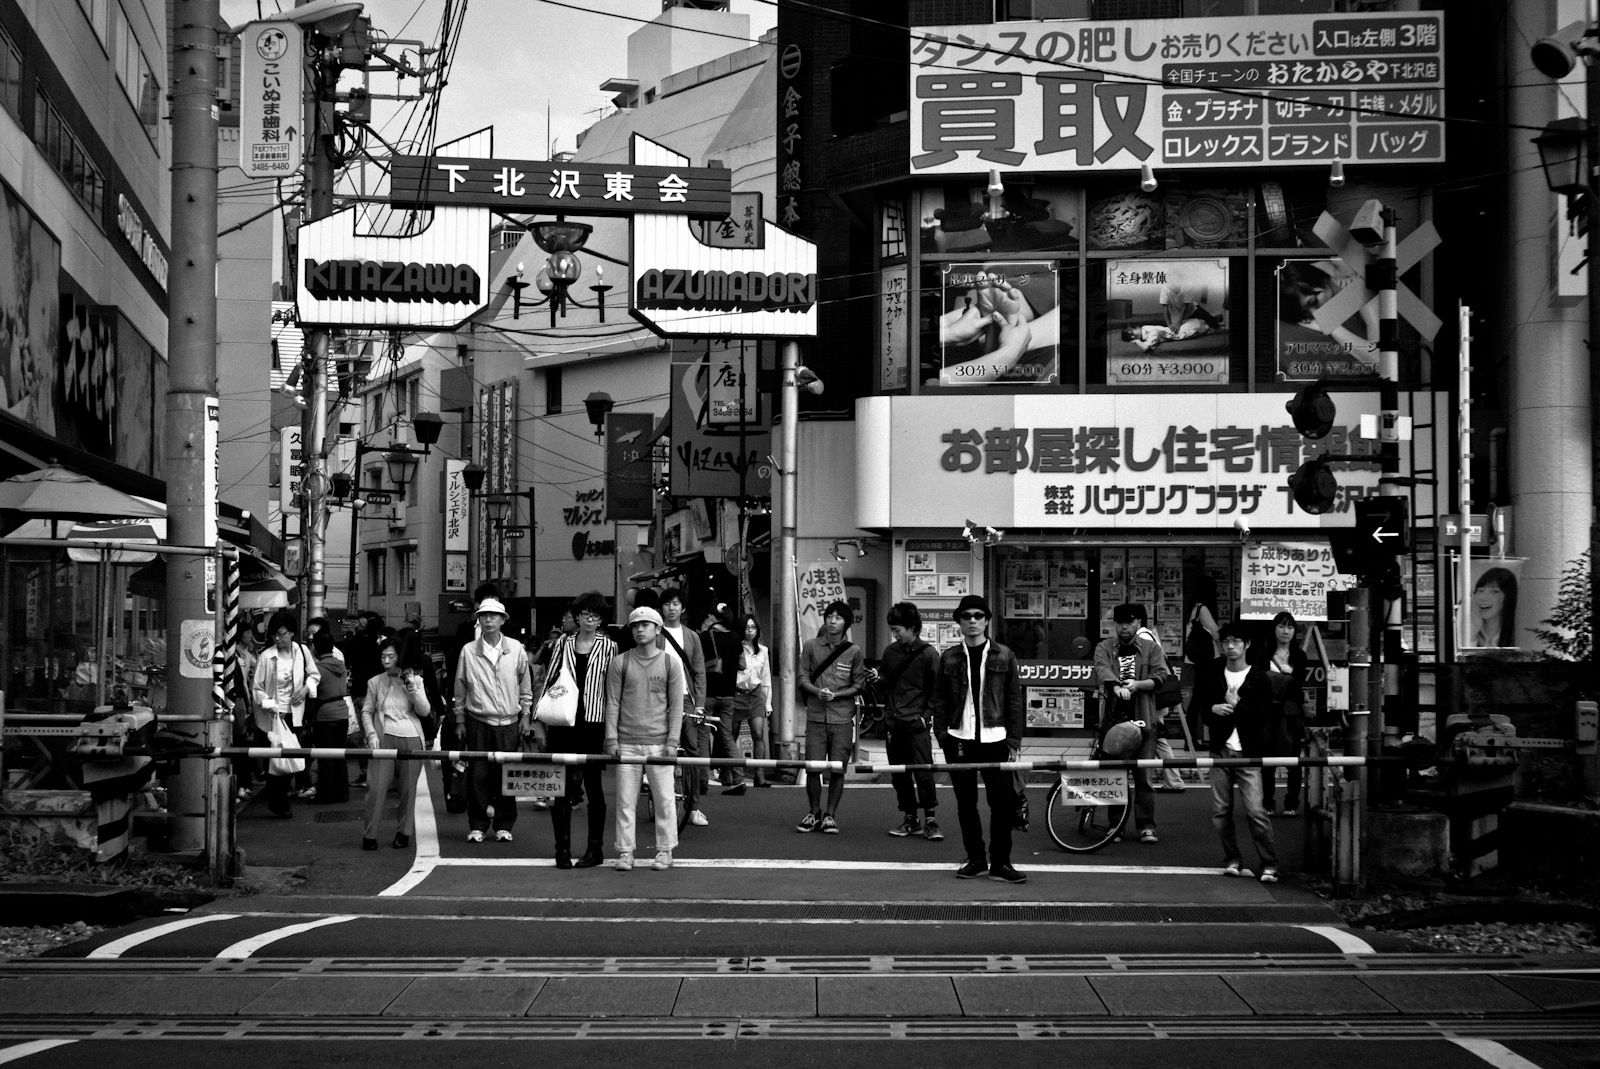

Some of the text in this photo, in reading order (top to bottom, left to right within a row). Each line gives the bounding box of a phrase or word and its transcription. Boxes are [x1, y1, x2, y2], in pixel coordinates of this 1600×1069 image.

[911, 26, 1310, 68] タンスの肥し お売りください
[1316, 23, 1437, 48] 入口は左側 3階
[1166, 60, 1438, 85] 全国チェーンの おたからや 下北沢店
[261, 63, 281, 142] こいぬま歯科
[1166, 98, 1259, 122] 金・プラチナ
[1275, 94, 1345, 120] 切手・刀
[1359, 92, 1438, 118] 古銭・メダル
[910, 70, 1156, 170] 買取
[1164, 134, 1261, 157] ロレックス
[1269, 132, 1349, 157] ブランド
[1368, 129, 1430, 154] バッグ
[252, 162, 290, 171] 3485-6480
[437, 163, 690, 204] 下北沢東会
[715, 217, 740, 239] 金
[305, 259, 478, 300] KITAZAWA
[642, 269, 817, 307] AZUMADORI
[1116, 271, 1168, 285] 全身整体
[955, 365, 986, 377] 30分
[1121, 363, 1153, 375] 60分
[447, 471, 460, 539] マルシェ下北沢
[1081, 483, 1381, 515] ハウジングプラザ 下沢
[1247, 562, 1335, 577] キャンペーン
[1066, 790, 1123, 800] 進んでください
